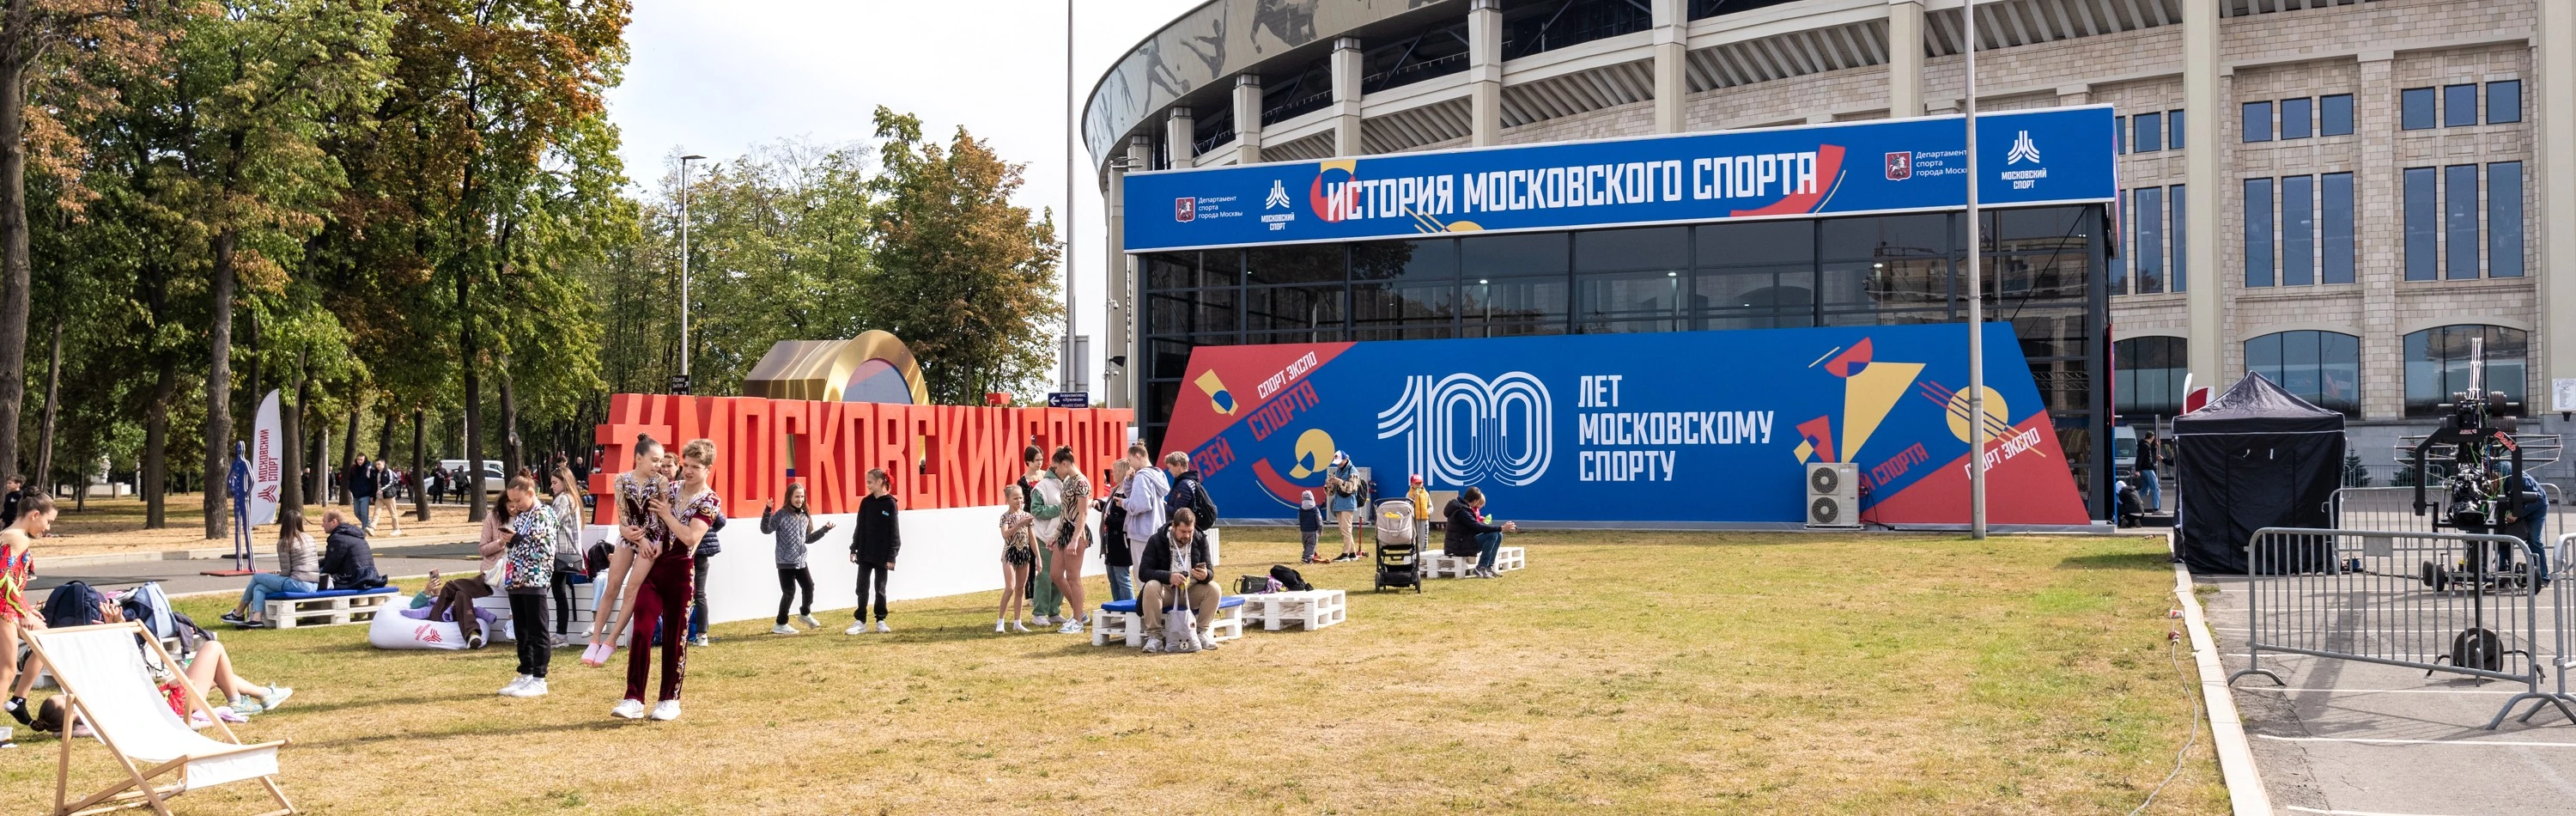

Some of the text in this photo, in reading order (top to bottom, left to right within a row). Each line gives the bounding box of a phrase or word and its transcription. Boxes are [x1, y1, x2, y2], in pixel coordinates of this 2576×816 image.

[1916, 149, 1967, 160] Департамент
[1916, 160, 1943, 168] спорта
[1327, 151, 1817, 222] ИСТОРИЯ МОСКОВСКОГО СПОРТА
[1916, 168, 1944, 177] города
[2001, 167, 2047, 180] МОСКОВСКИЙ
[2013, 180, 2035, 190] СПОРТ
[1198, 196, 1237, 204] Департамент
[1261, 212, 1295, 223] МОСКОВСКИЙ
[1269, 222, 1286, 231] СПОРТ
[1257, 350, 1317, 399] СПОРТ ЭКСПО
[1577, 375, 1622, 408] ЛЕТ
[1188, 380, 1320, 483] УЗЕЙ СПОРТА
[1377, 371, 1552, 486] 100
[1579, 411, 1774, 445] МОСКОВСКОМУ
[258, 429, 270, 483] МОСКОВСКИЙ
[268, 456, 279, 482] СПОРТ
[1579, 450, 1675, 482] СПОРТУ
[1871, 441, 1929, 486] СПОРТА
[1964, 426, 2041, 480] СОРТ ЭКСПО
